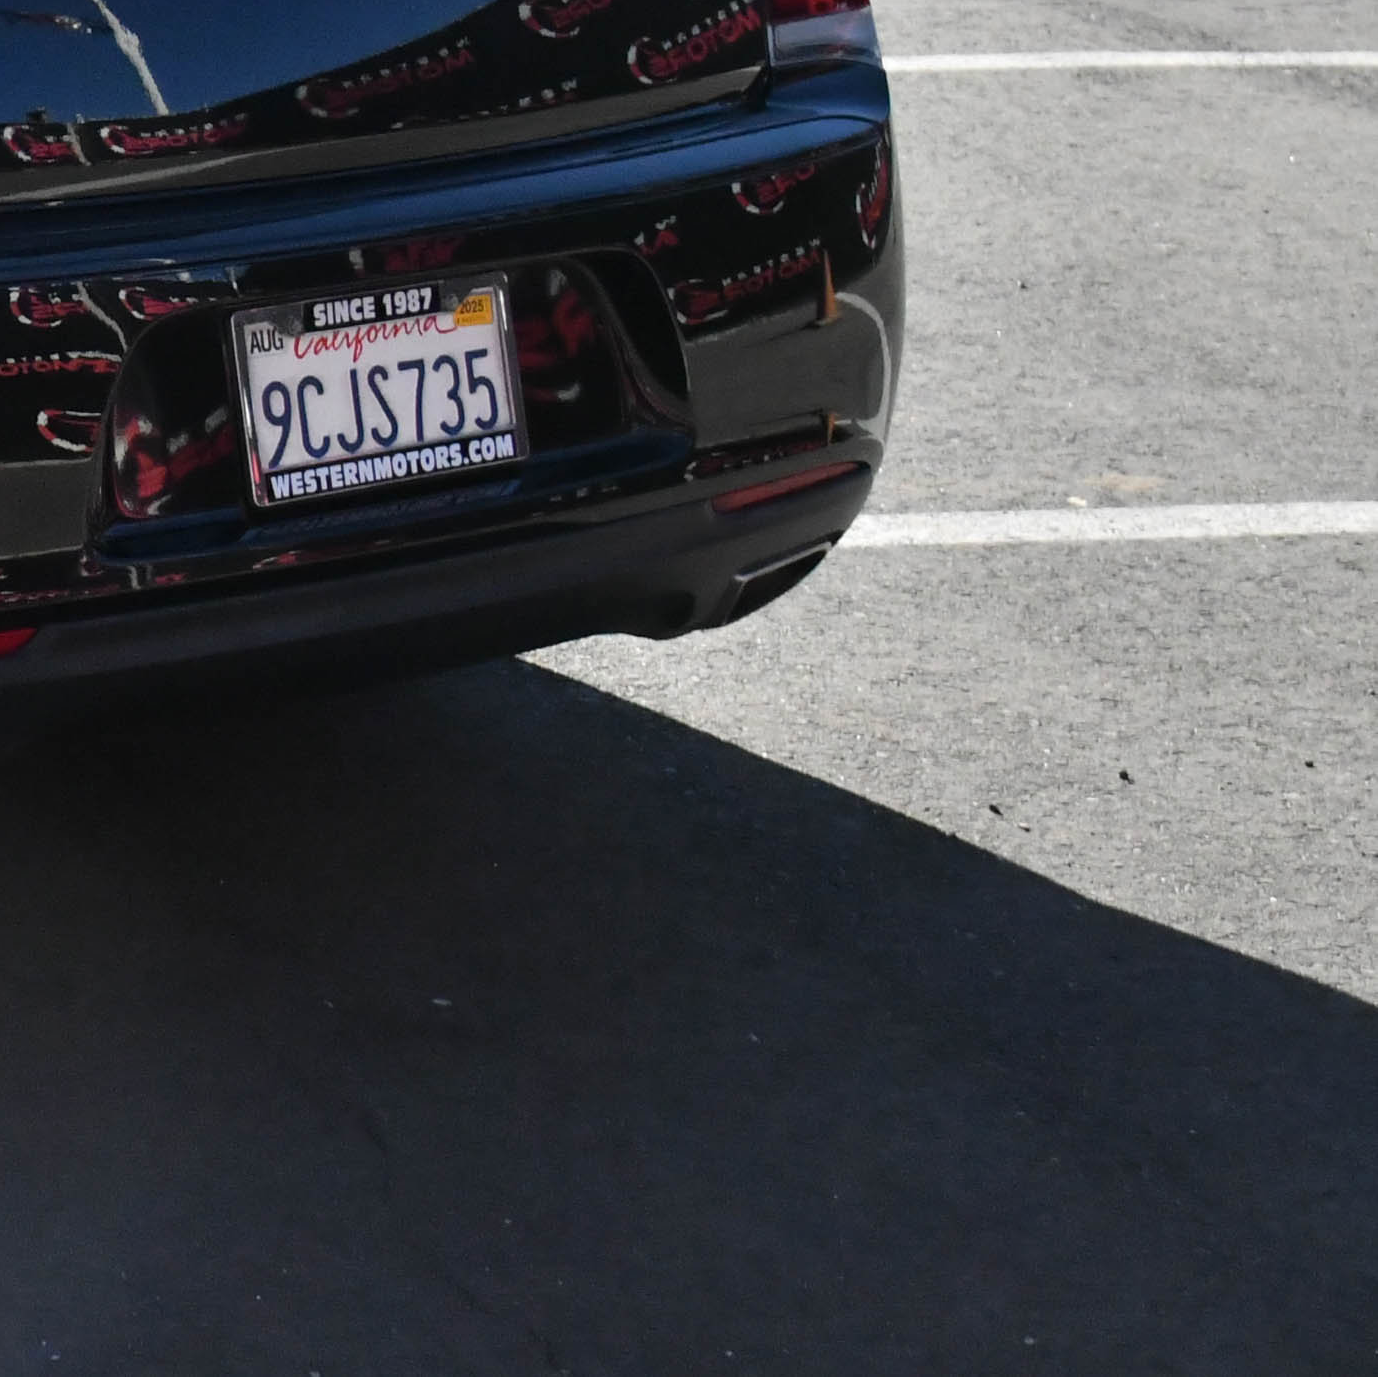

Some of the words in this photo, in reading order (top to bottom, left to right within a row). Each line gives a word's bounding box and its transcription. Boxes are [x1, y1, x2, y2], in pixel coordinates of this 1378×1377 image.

[313, 300, 375, 327] SINCE
[383, 287, 432, 315] 1987
[459, 300, 484, 314] 2025
[250, 328, 283, 354] AUG
[294, 314, 458, 362] California
[262, 348, 498, 469] 9CJS735
[270, 434, 514, 499] WESTERNMOTORS.COM
